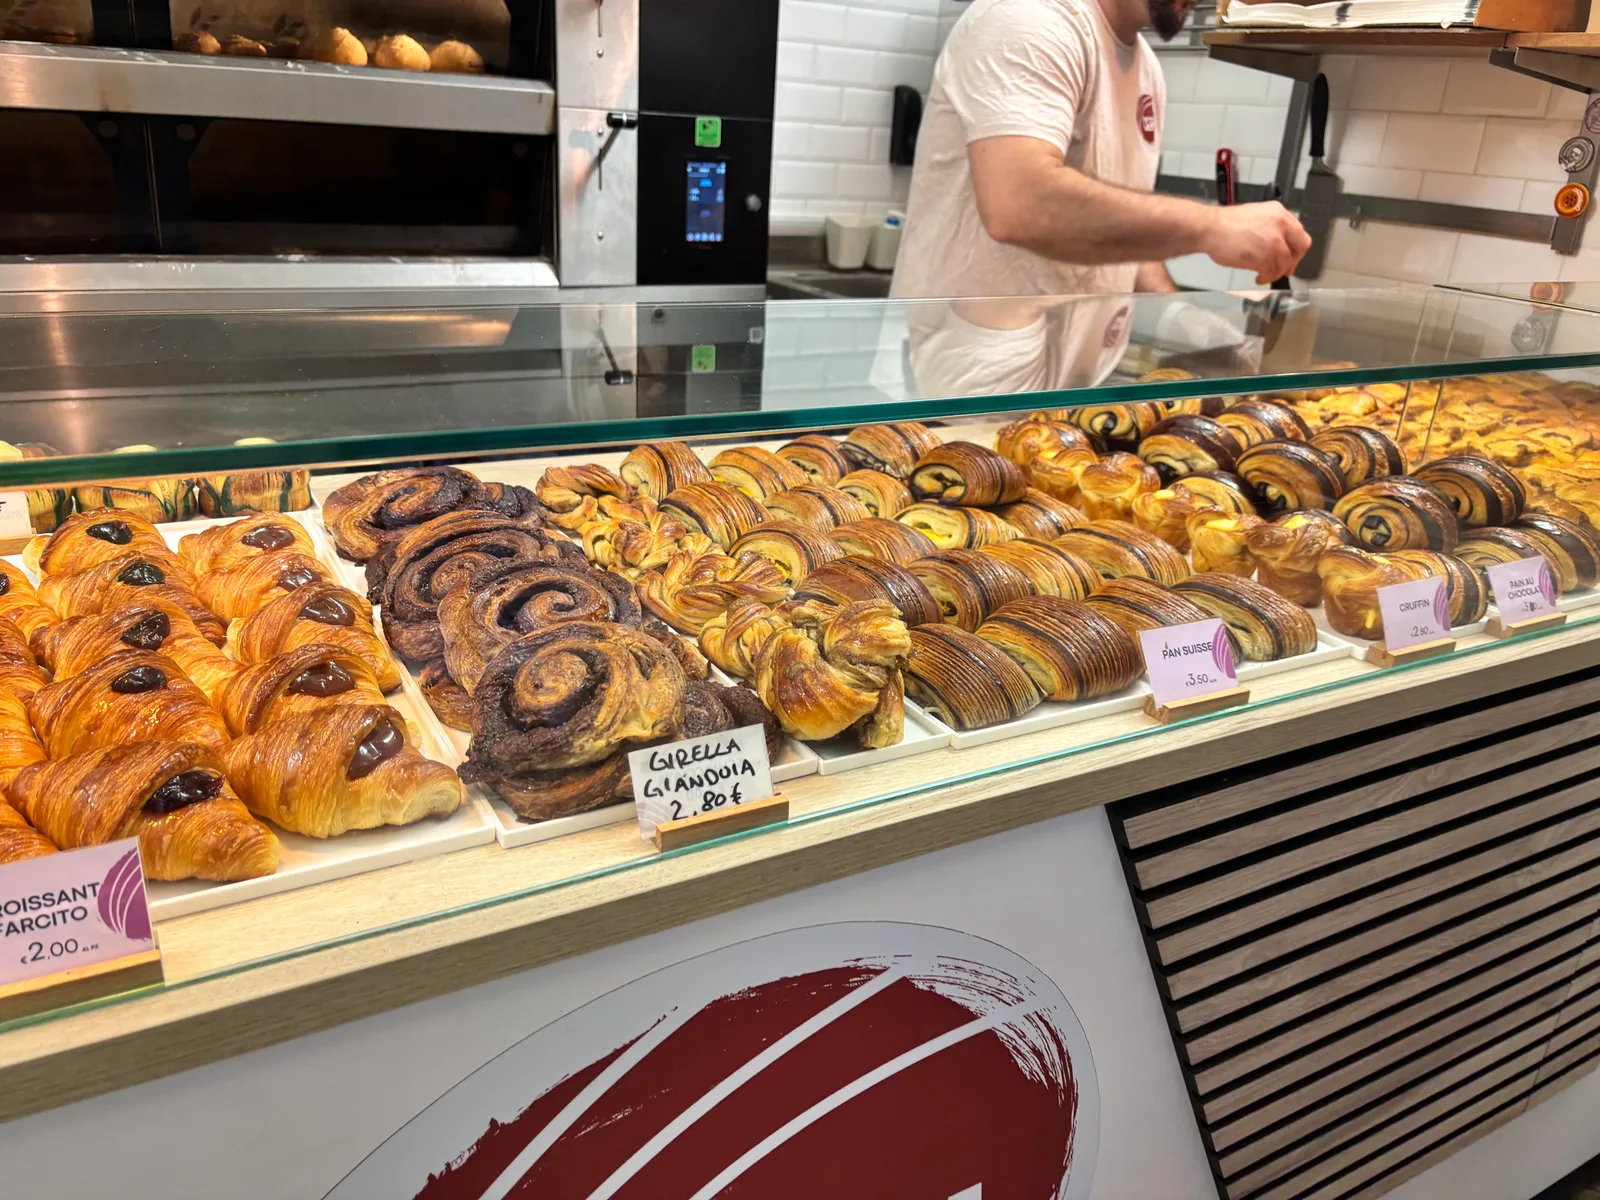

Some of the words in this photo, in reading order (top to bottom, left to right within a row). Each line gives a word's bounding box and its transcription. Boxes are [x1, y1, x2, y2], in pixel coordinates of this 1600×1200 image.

[1509, 580, 1525, 589] PAIN
[1399, 598, 1430, 612] CRUFFIN
[1162, 647, 1182, 660] PAN
[1183, 641, 1213, 656] SUISSE
[649, 738, 741, 772] GIRELLA
[643, 759, 756, 798] GIANDUIA
